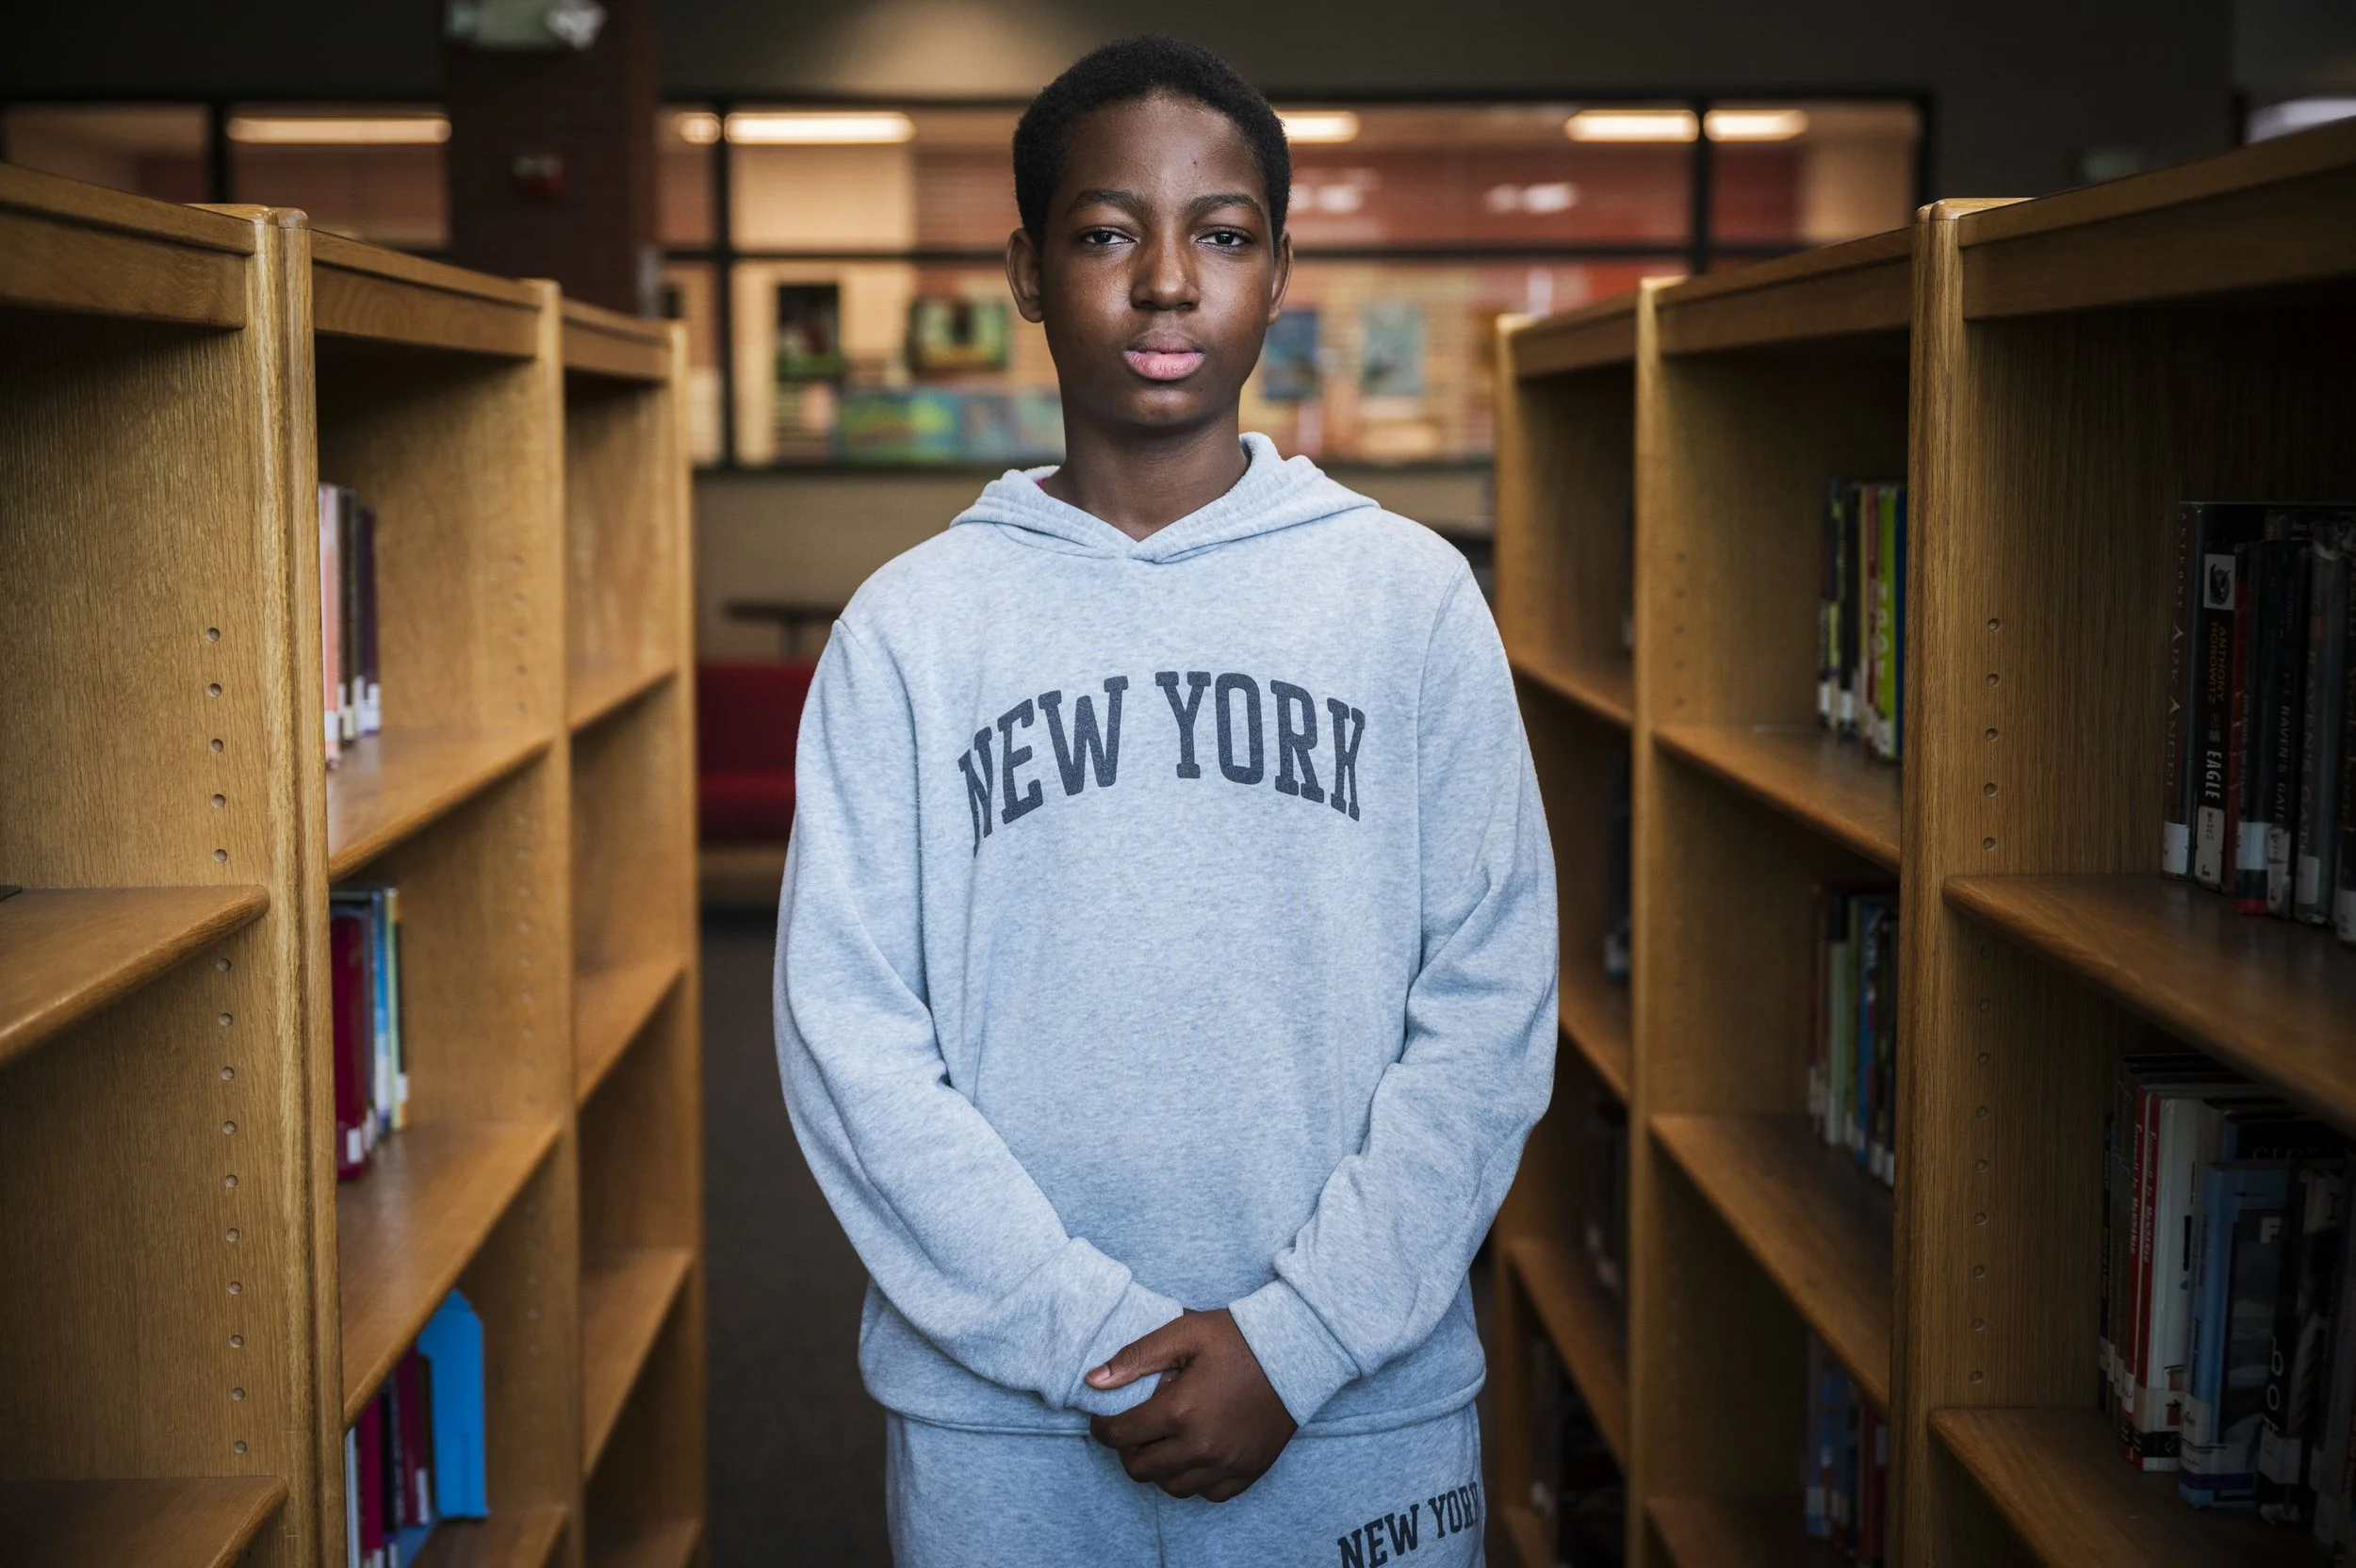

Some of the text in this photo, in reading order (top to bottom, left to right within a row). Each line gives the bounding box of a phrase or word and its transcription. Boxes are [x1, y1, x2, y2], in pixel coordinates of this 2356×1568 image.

[2207, 622, 2219, 705] HOROWITZ
[2217, 625, 2228, 702] ANTHONY
[957, 670, 1366, 857] NEW YORK
[2204, 750, 2222, 800] EAGLE
[2278, 705, 2291, 774] RAVEN'S
[1337, 1480, 1480, 1568] NEW YORK
